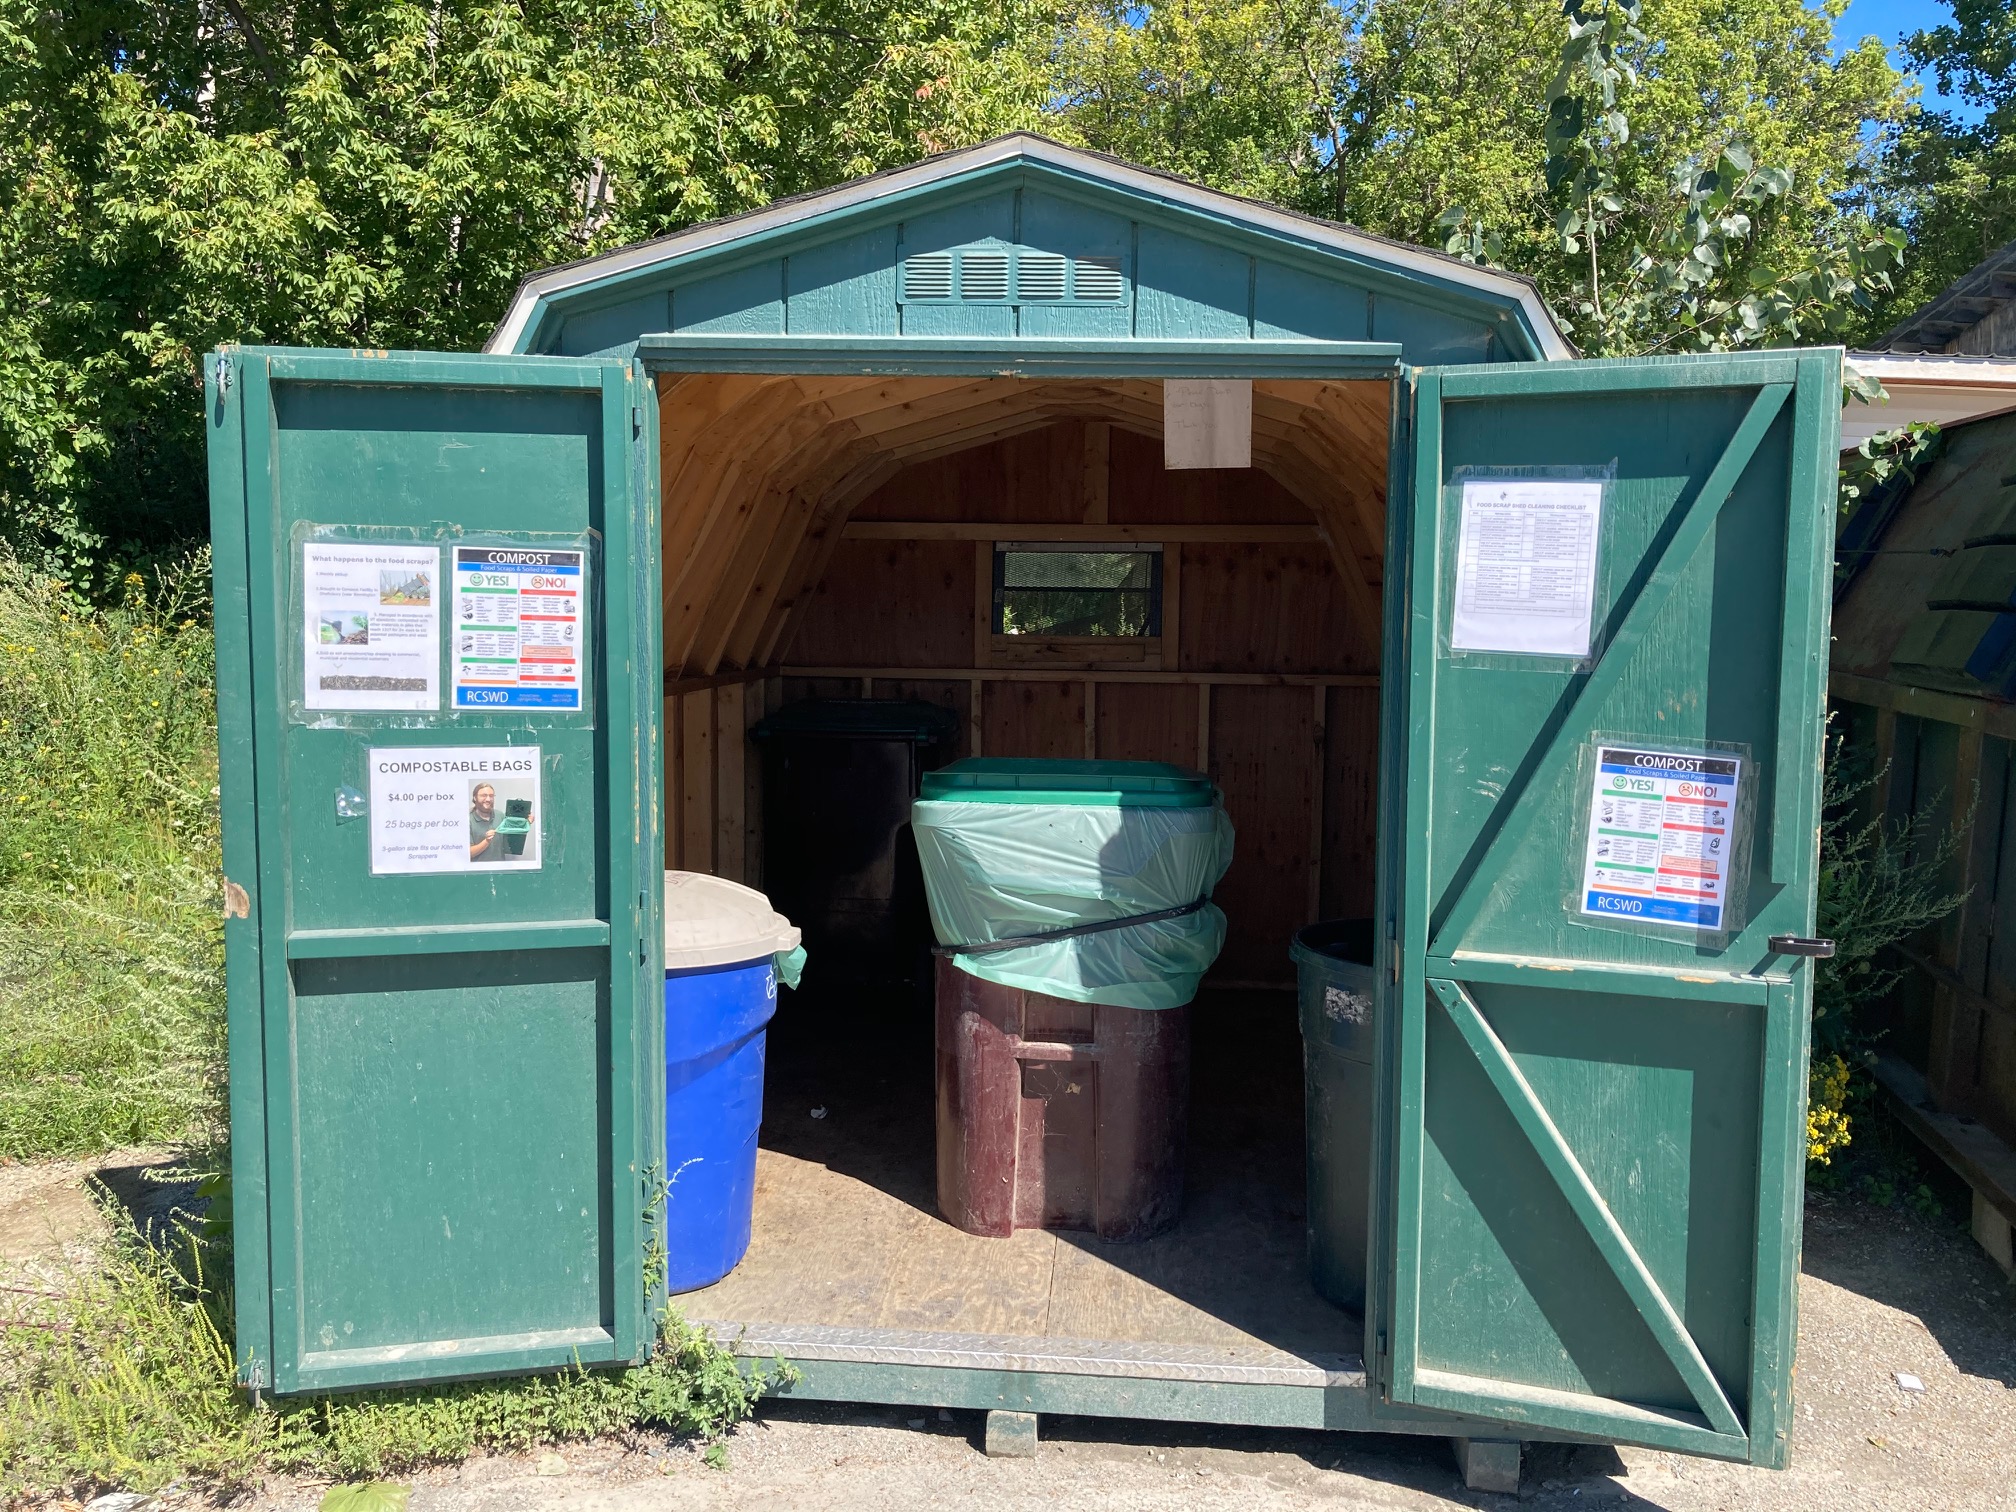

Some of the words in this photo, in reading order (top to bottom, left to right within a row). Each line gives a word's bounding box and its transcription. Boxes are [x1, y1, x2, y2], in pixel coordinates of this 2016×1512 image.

[333, 555, 364, 564] happens
[406, 558, 434, 566] scraps?
[488, 552, 551, 565] COMPOST
[496, 565, 516, 573] Scraps
[485, 575, 509, 586] YES!
[545, 578, 566, 588] NO!
[467, 691, 509, 703] RCSWD
[379, 761, 488, 774] COMPOSTABLE
[492, 760, 533, 772] BAGS
[1634, 755, 1703, 772] COMPOST
[1642, 769, 1663, 777] Scraps
[1670, 771, 1689, 780] Soiled
[1690, 773, 1709, 781] Paper
[1630, 778, 1655, 792] YES!
[388, 793, 414, 801] $4.00
[417, 794, 433, 802] per
[436, 793, 455, 801] box
[1694, 785, 1718, 798] NO!
[385, 820, 397, 828] 25
[399, 819, 422, 830] bags
[424, 821, 440, 830] per
[443, 819, 460, 827] box
[1597, 896, 1642, 913] RCSWD
